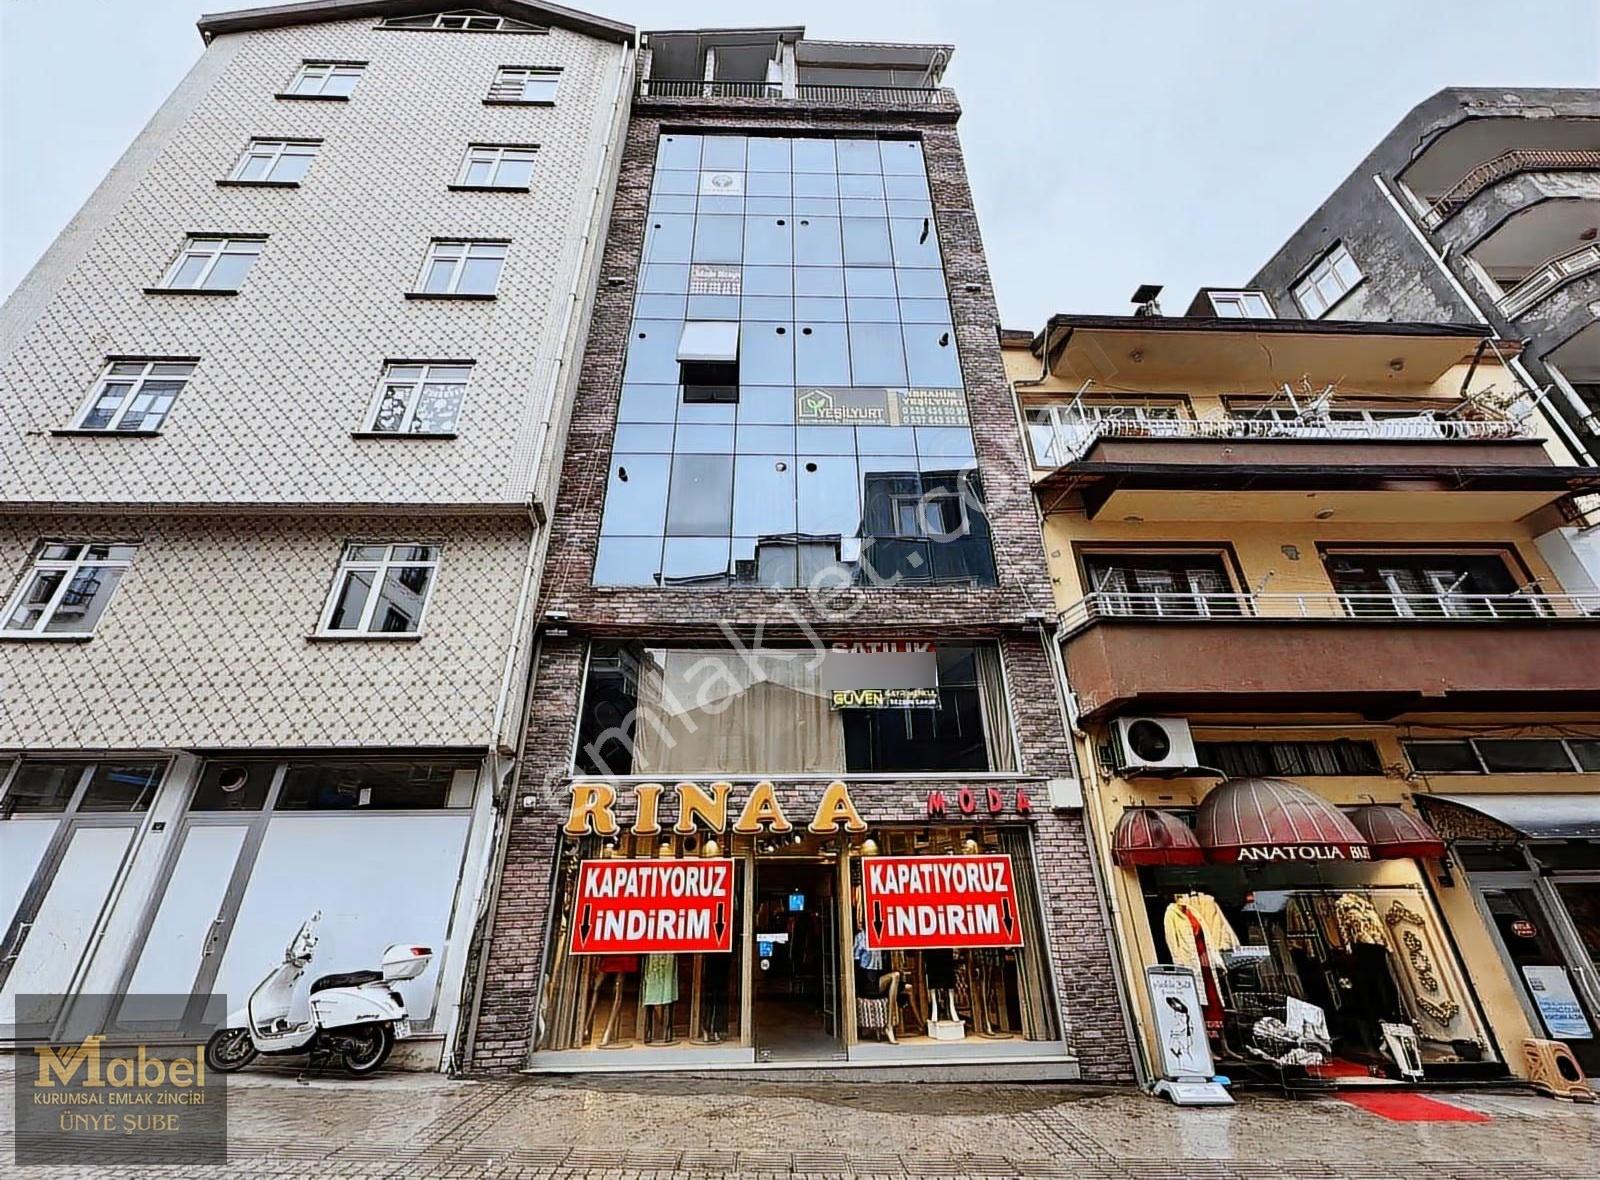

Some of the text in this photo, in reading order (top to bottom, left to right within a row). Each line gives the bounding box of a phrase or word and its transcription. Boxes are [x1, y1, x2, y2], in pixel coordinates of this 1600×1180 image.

[816, 405, 884, 420] YEŞİLYURT
[927, 784, 1032, 816] MODA
[1237, 845, 1346, 861] ANATOLIA
[584, 866, 728, 898] KAPATIYORUZ
[869, 862, 1009, 895] KAPATIYORUZ
